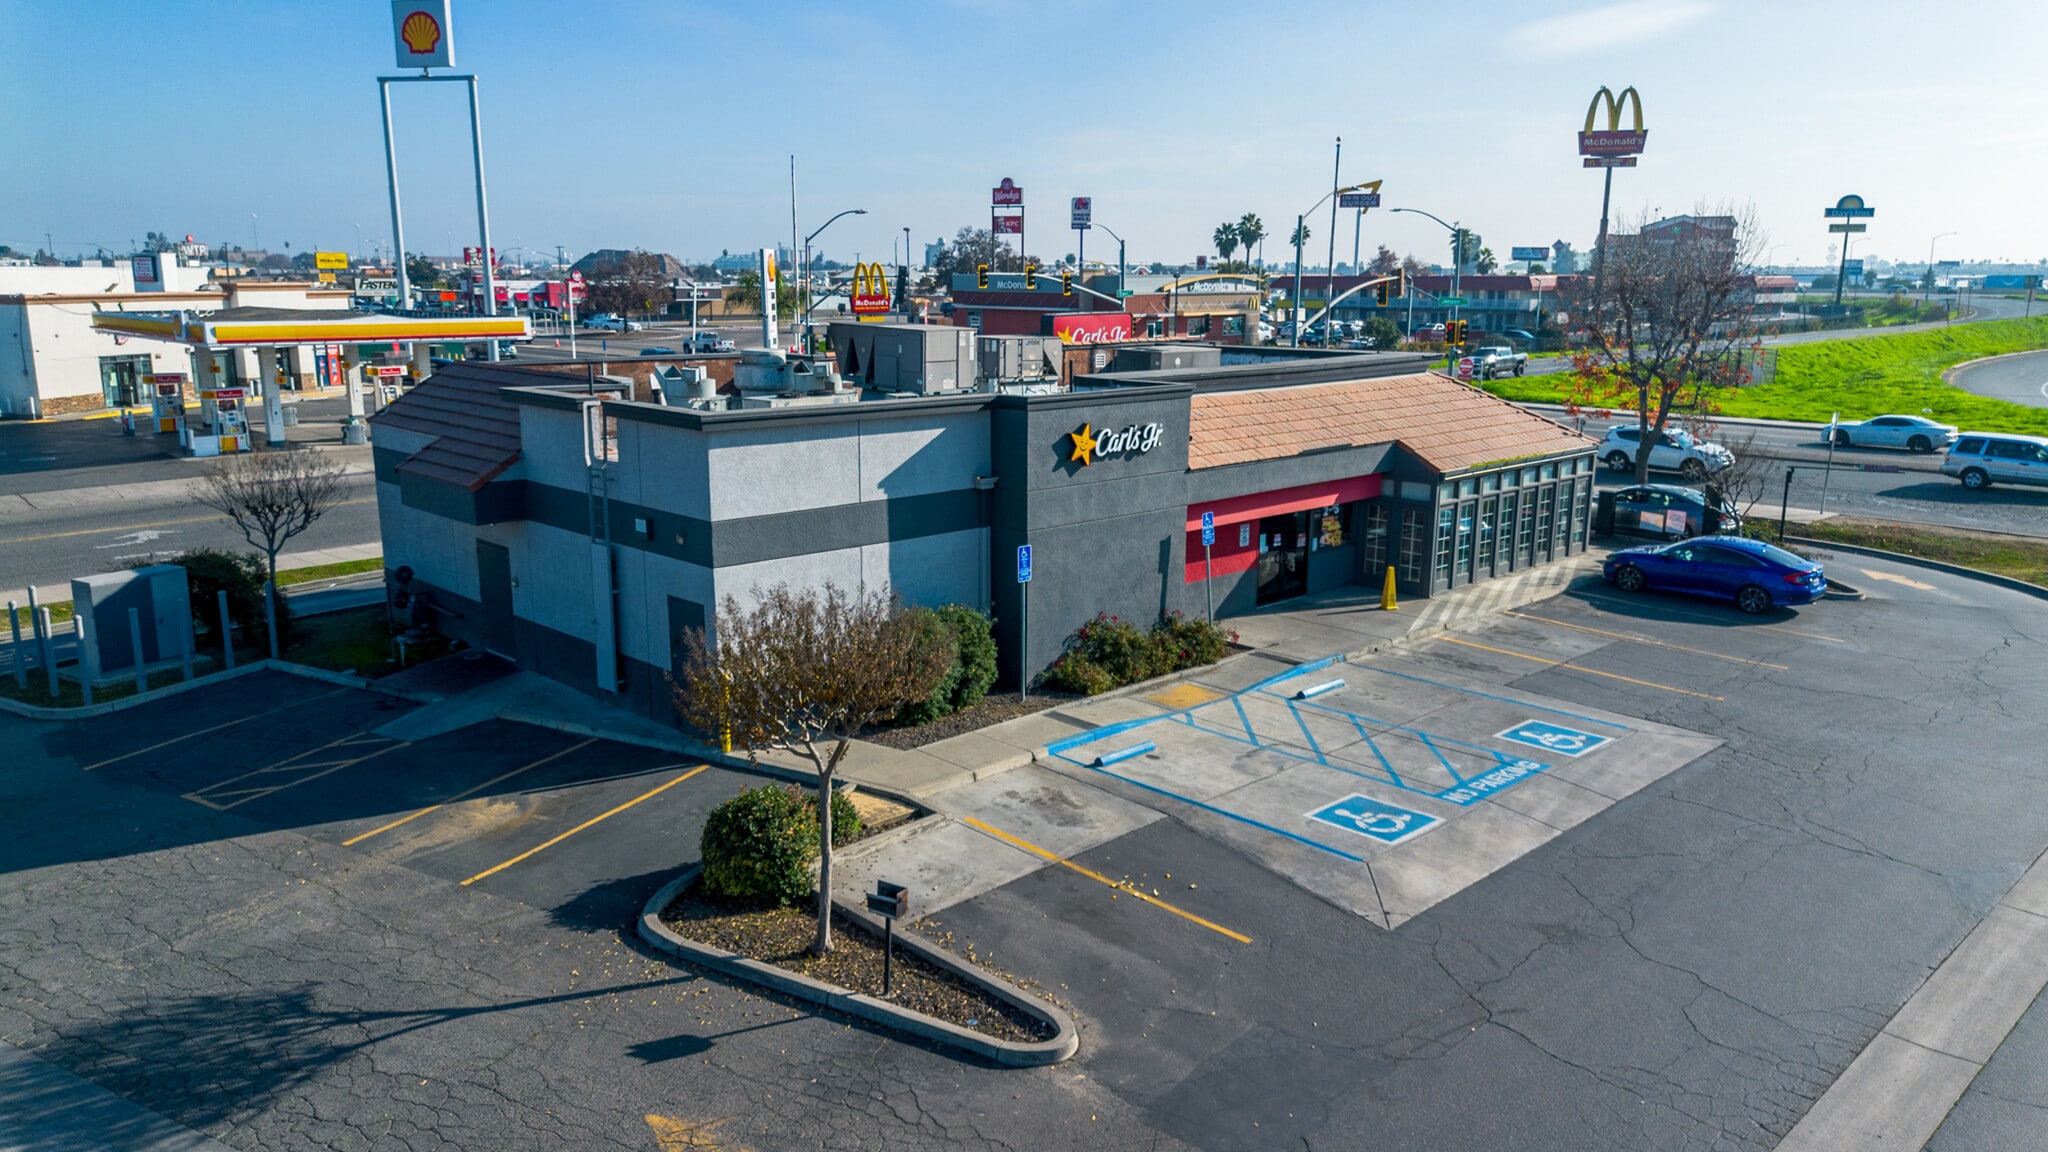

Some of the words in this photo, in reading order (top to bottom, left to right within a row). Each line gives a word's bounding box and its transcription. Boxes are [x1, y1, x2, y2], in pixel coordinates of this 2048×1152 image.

[1584, 136, 1643, 146] McDonald's
[995, 190, 1020, 202] Wendy's
[997, 281, 1037, 289] McDonas
[1072, 325, 1108, 342] Carl's
[1095, 424, 1141, 457] Carl's
[1442, 789, 1478, 803] NO
[1468, 760, 1540, 791] PARKING
